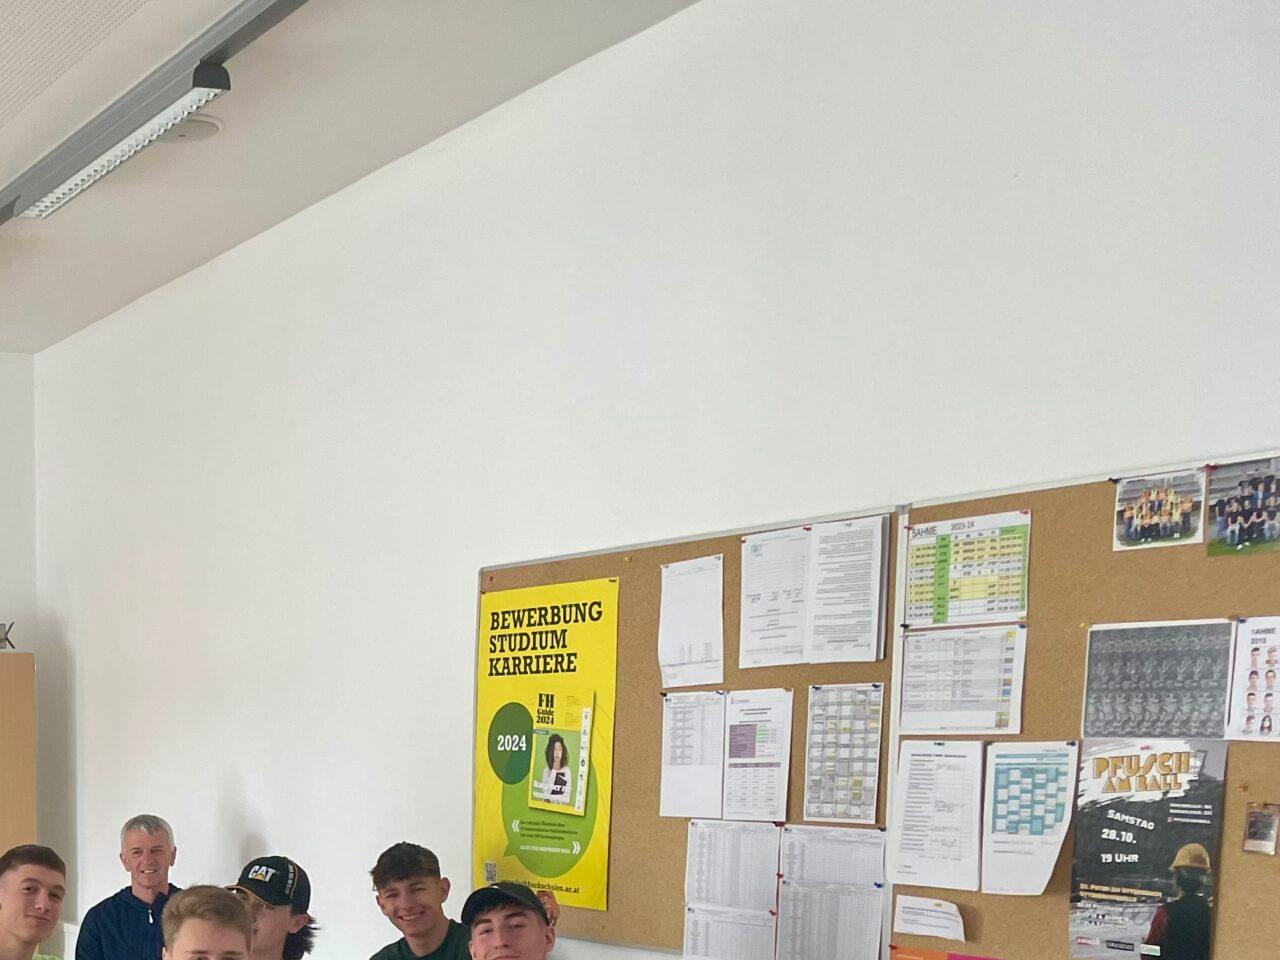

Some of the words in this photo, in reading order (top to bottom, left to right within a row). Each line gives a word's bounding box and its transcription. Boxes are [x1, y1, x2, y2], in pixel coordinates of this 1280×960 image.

[490, 601, 602, 631] BEWERBUNG
[489, 629, 568, 653] STUDIUM
[488, 652, 577, 677] KARRIERE
[538, 693, 555, 708] FH
[536, 708, 555, 716] Guide
[536, 716, 554, 725] 2024
[497, 735, 527, 751] 2024
[1093, 752, 1190, 779] PFUSCH
[1107, 809, 1155, 830] SAMSTAG
[1101, 853, 1113, 863] 19
[1114, 853, 1139, 863] UHR
[248, 865, 277, 883] CAT
